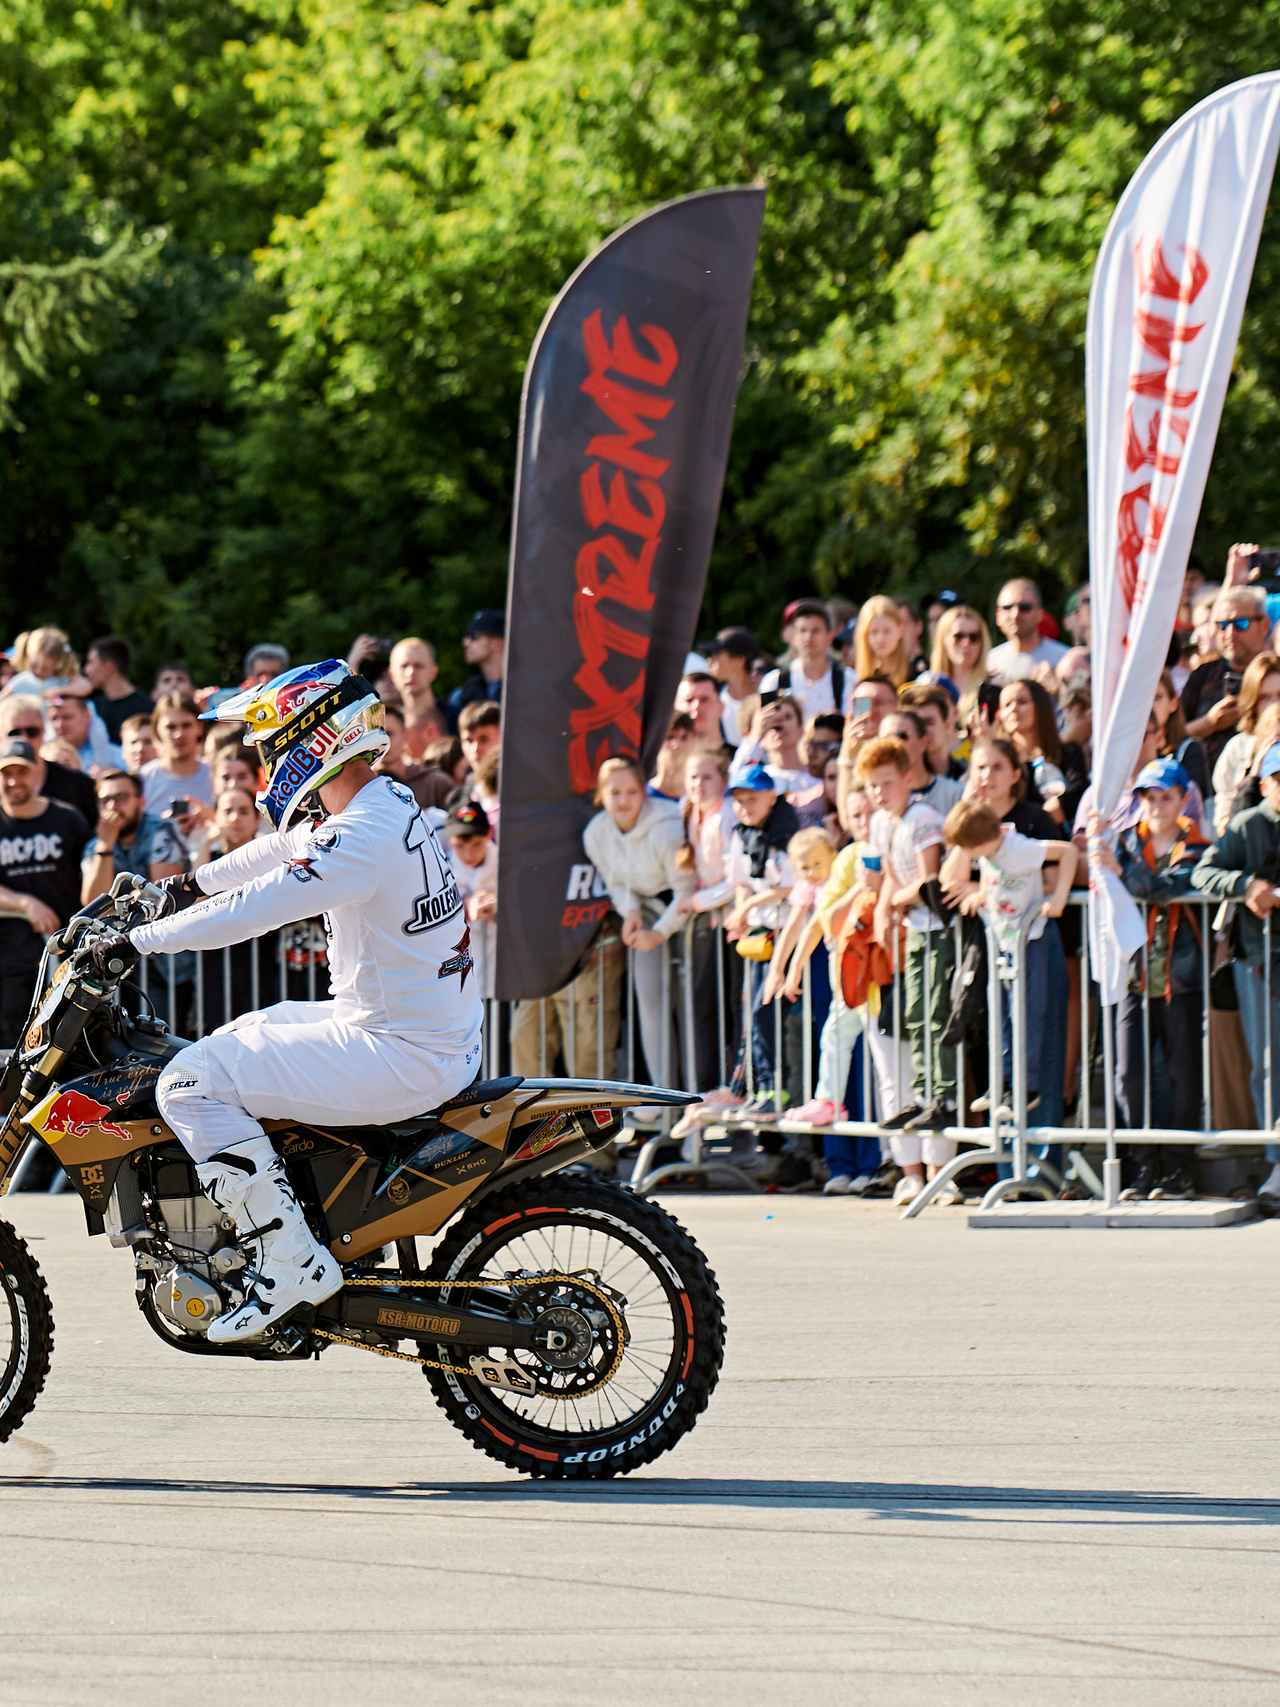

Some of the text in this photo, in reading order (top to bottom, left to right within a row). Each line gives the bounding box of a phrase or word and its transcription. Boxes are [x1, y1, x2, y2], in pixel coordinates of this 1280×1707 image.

[569, 307, 680, 795] EXTREME
[274, 691, 342, 751] SCOTT
[344, 729, 363, 745] BELL
[282, 1139, 314, 1155] cardo
[434, 1151, 471, 1170] DUNLOP
[563, 1401, 678, 1464] DUNLOP
